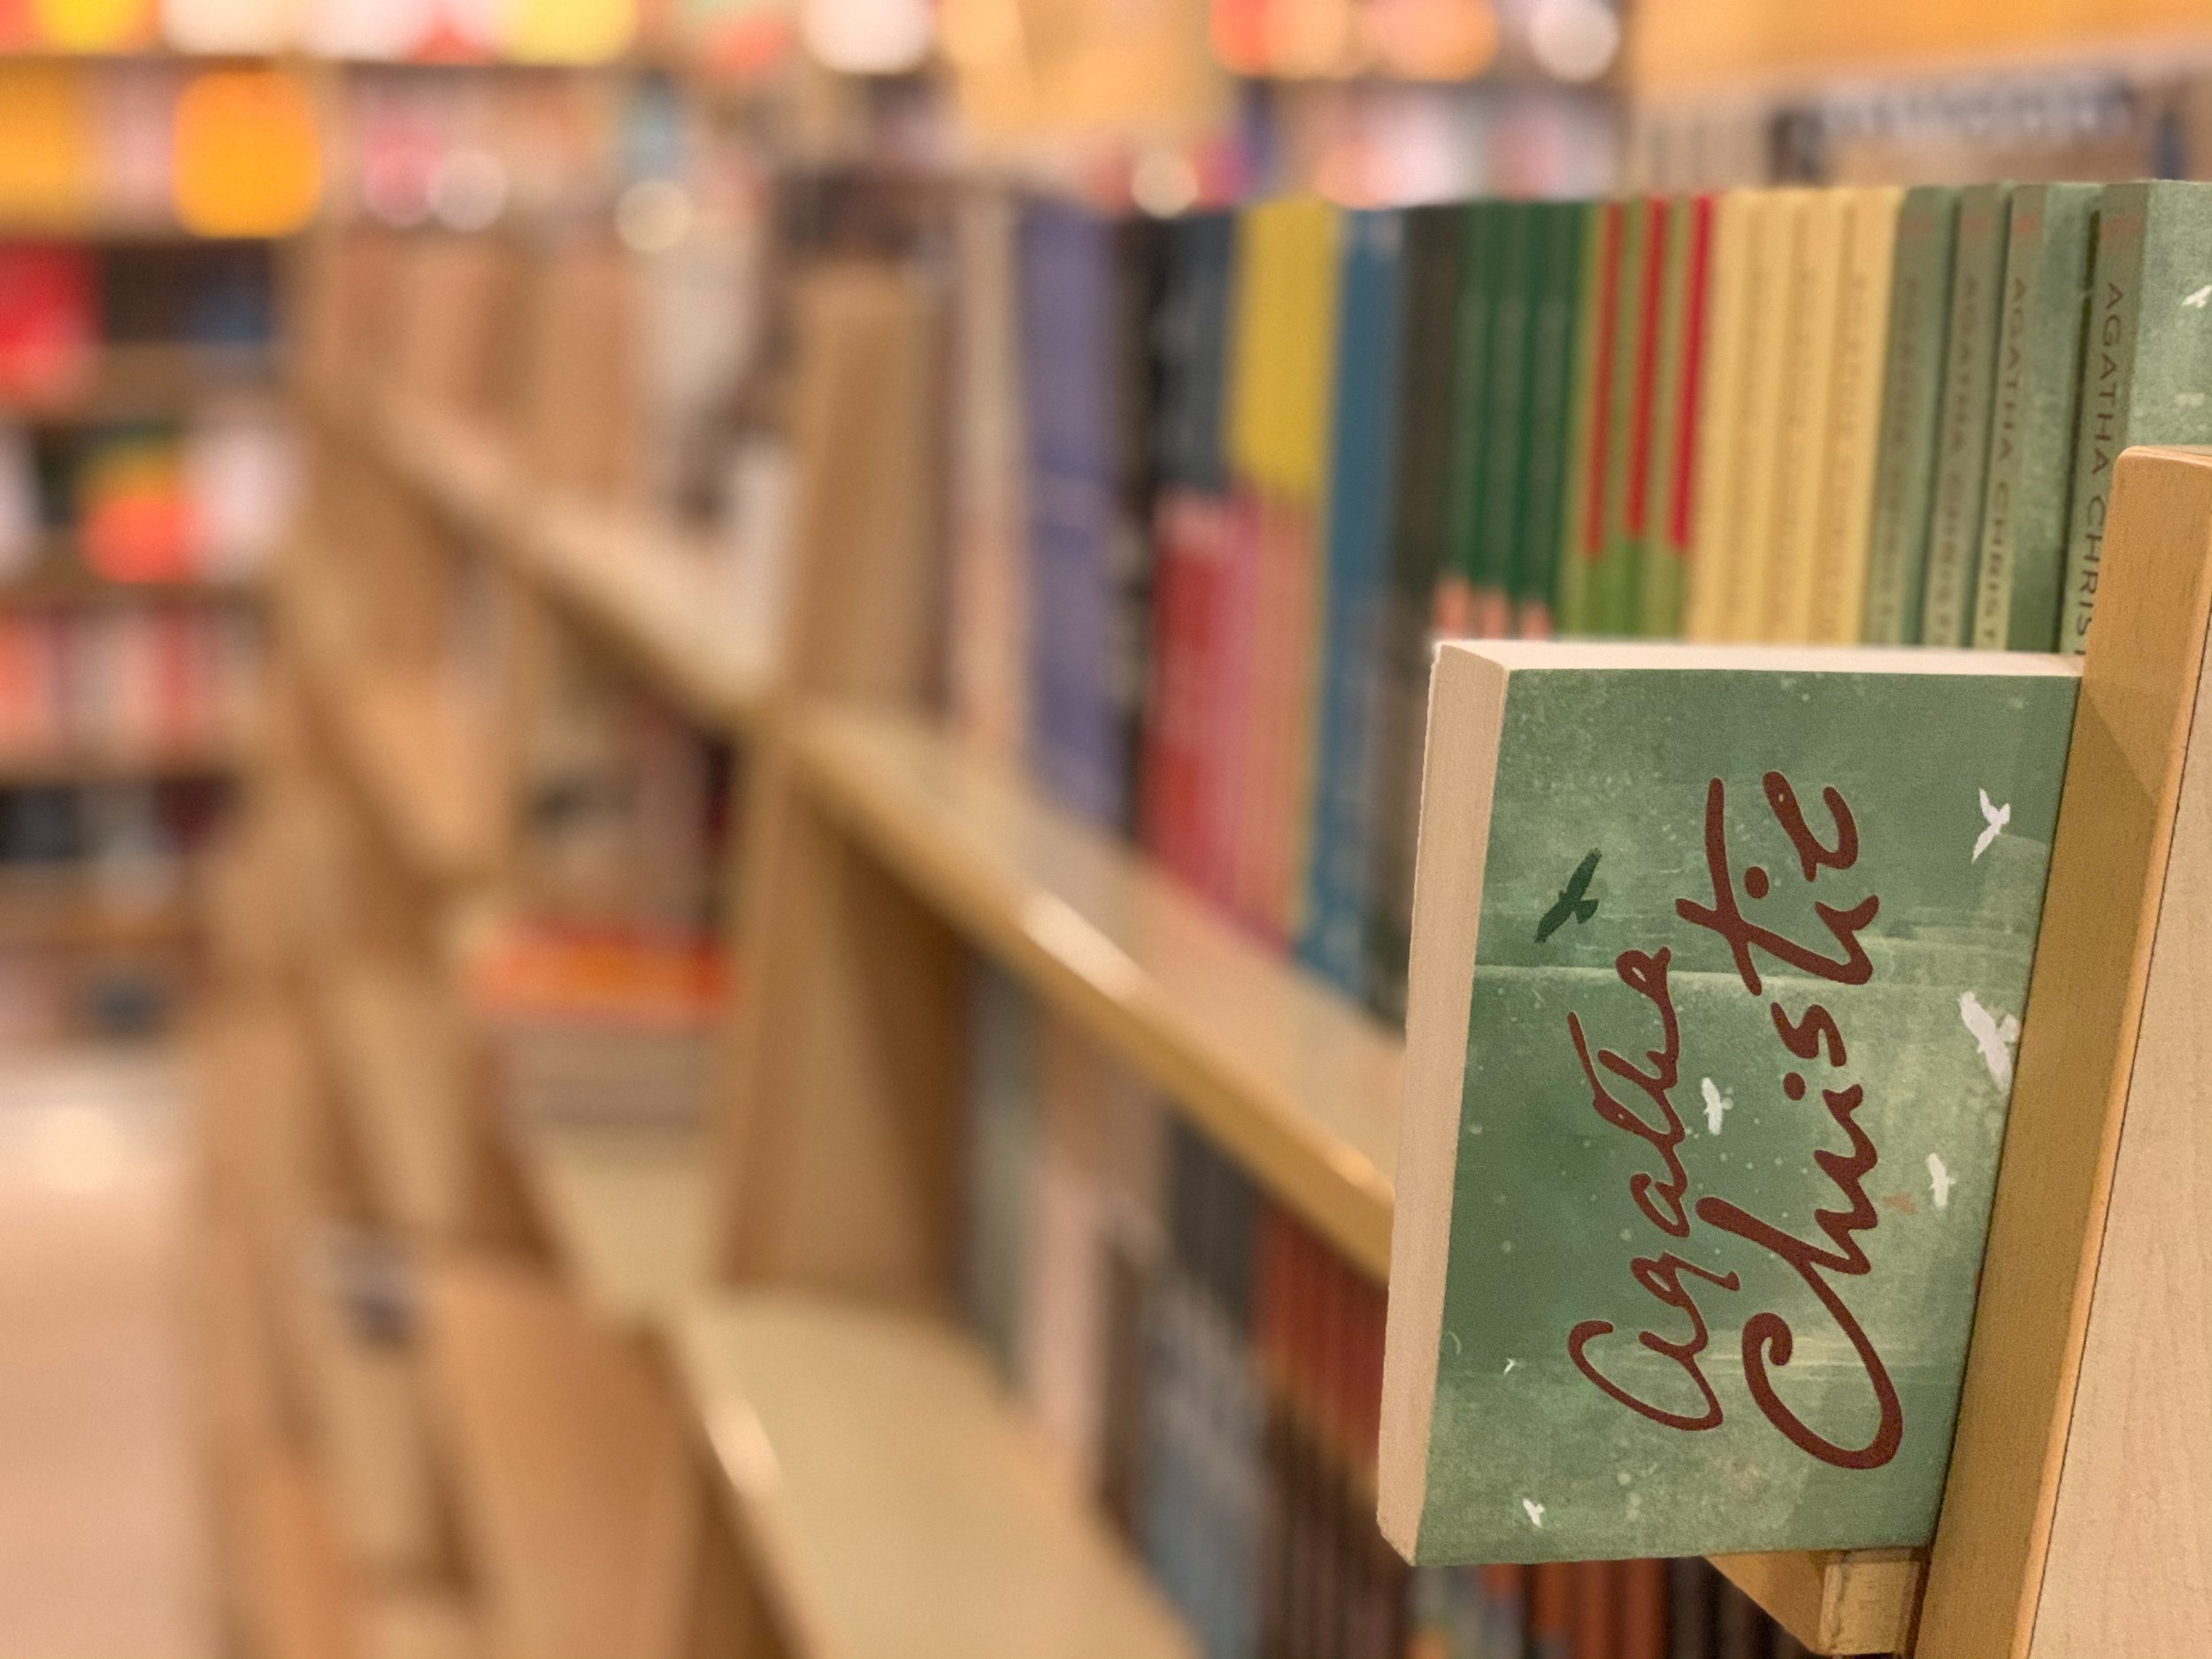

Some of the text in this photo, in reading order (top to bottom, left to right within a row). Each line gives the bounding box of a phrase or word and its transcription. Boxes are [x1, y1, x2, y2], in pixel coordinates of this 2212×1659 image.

[1998, 277, 2026, 462] AGATHA
[2093, 281, 2124, 475] AGATHA
[1567, 947, 1741, 1432] Agatha
[1675, 771, 1904, 1471] Christie
